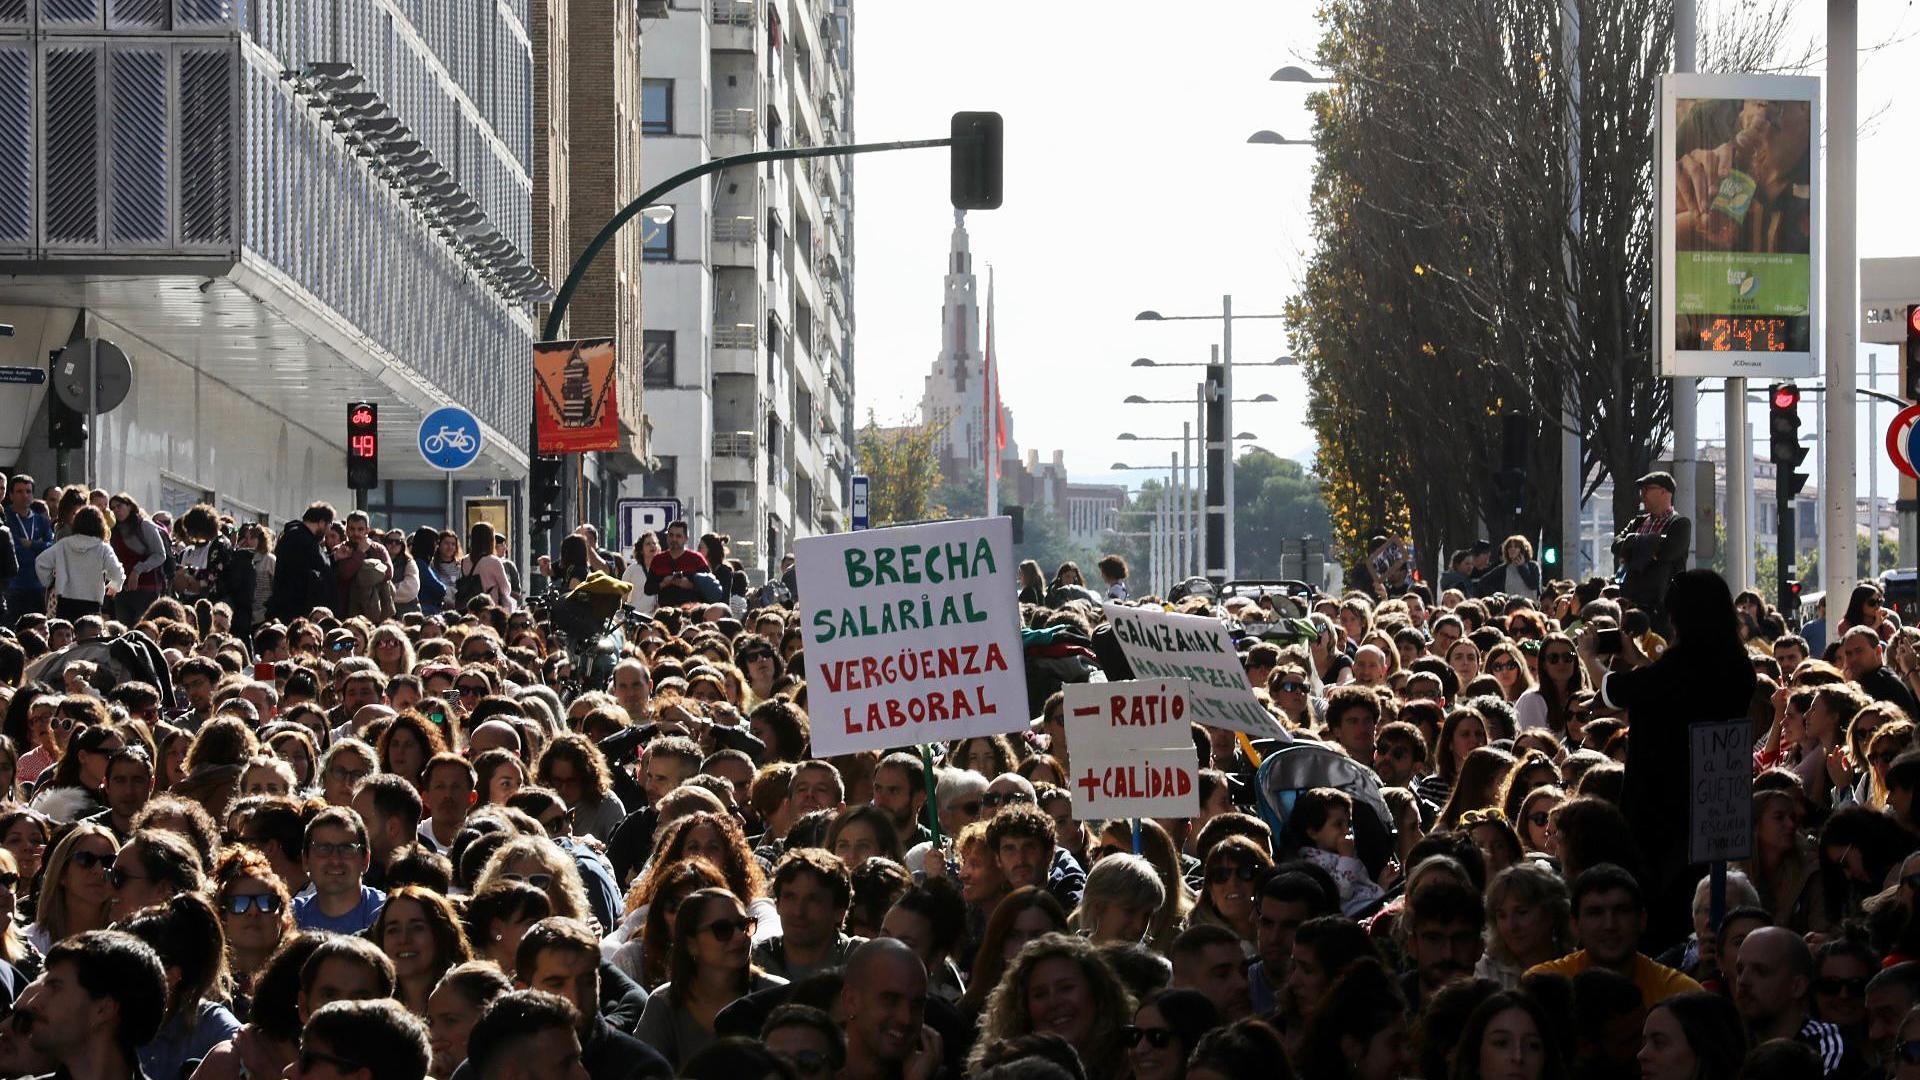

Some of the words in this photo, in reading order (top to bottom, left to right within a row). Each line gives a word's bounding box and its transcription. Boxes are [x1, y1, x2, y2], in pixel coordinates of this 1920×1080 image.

[352, 435, 374, 457] 49
[631, 507, 666, 547] P
[843, 536, 997, 588] BRECHA
[819, 642, 1009, 694] VERGÜENZA
[843, 685, 997, 735] LABORAL
[1697, 776, 1750, 804] GUETOS
